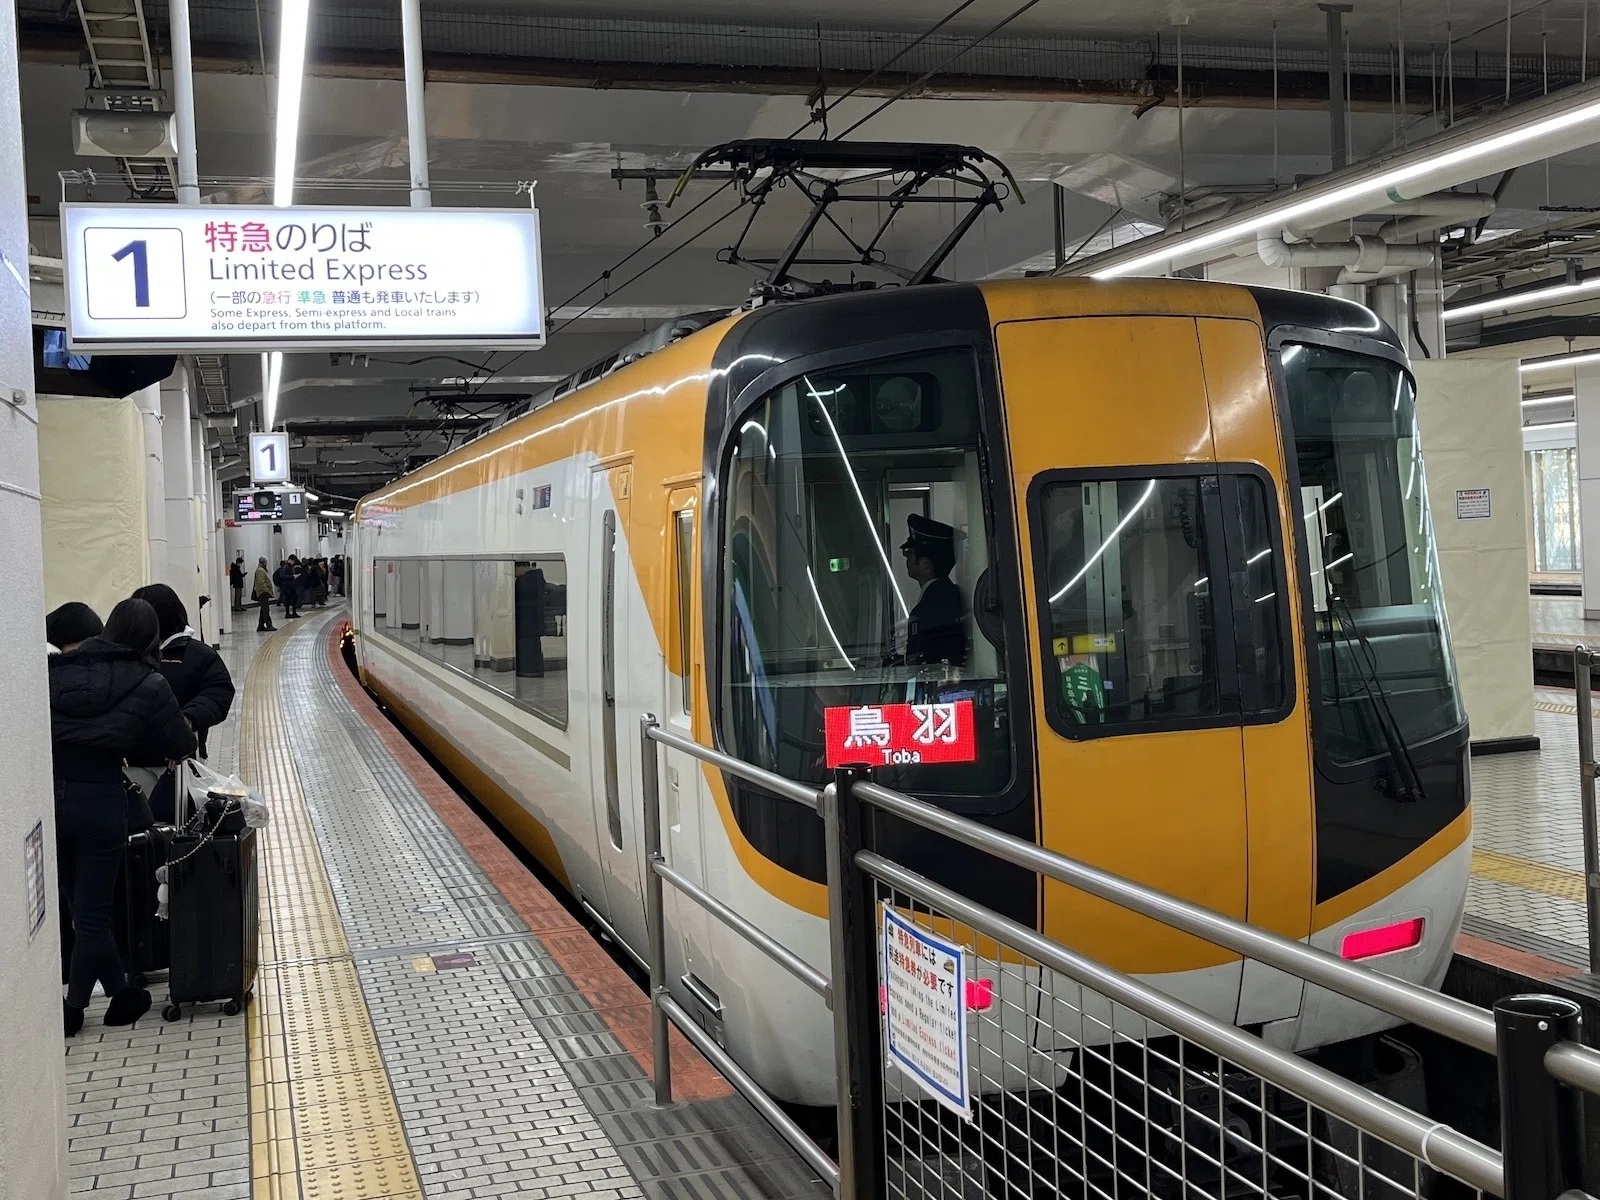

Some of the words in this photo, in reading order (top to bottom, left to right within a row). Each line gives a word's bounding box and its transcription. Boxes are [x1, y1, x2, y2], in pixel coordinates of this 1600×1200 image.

[204, 221, 373, 253] 特急のりば
[111, 240, 150, 307] 1
[209, 257, 315, 280] Limited
[326, 258, 428, 286] Express
[296, 290, 327, 305] 準急
[210, 308, 243, 318] Some
[246, 308, 292, 320] Express,
[295, 307, 367, 320] Semi-express
[370, 307, 391, 317] and
[395, 307, 423, 317] Local
[426, 307, 457, 317] trains
[211, 320, 234, 331] also
[237, 321, 277, 333] depart
[279, 320, 308, 330] from
[311, 320, 331, 330] this
[334, 320, 387, 332] platform.
[260, 443, 276, 471] 1
[843, 704, 957, 748] 鳥羽
[881, 749, 921, 764] Toba
[898, 928, 937, 966] 特急列車には
[935, 1000, 957, 1021] Limited
